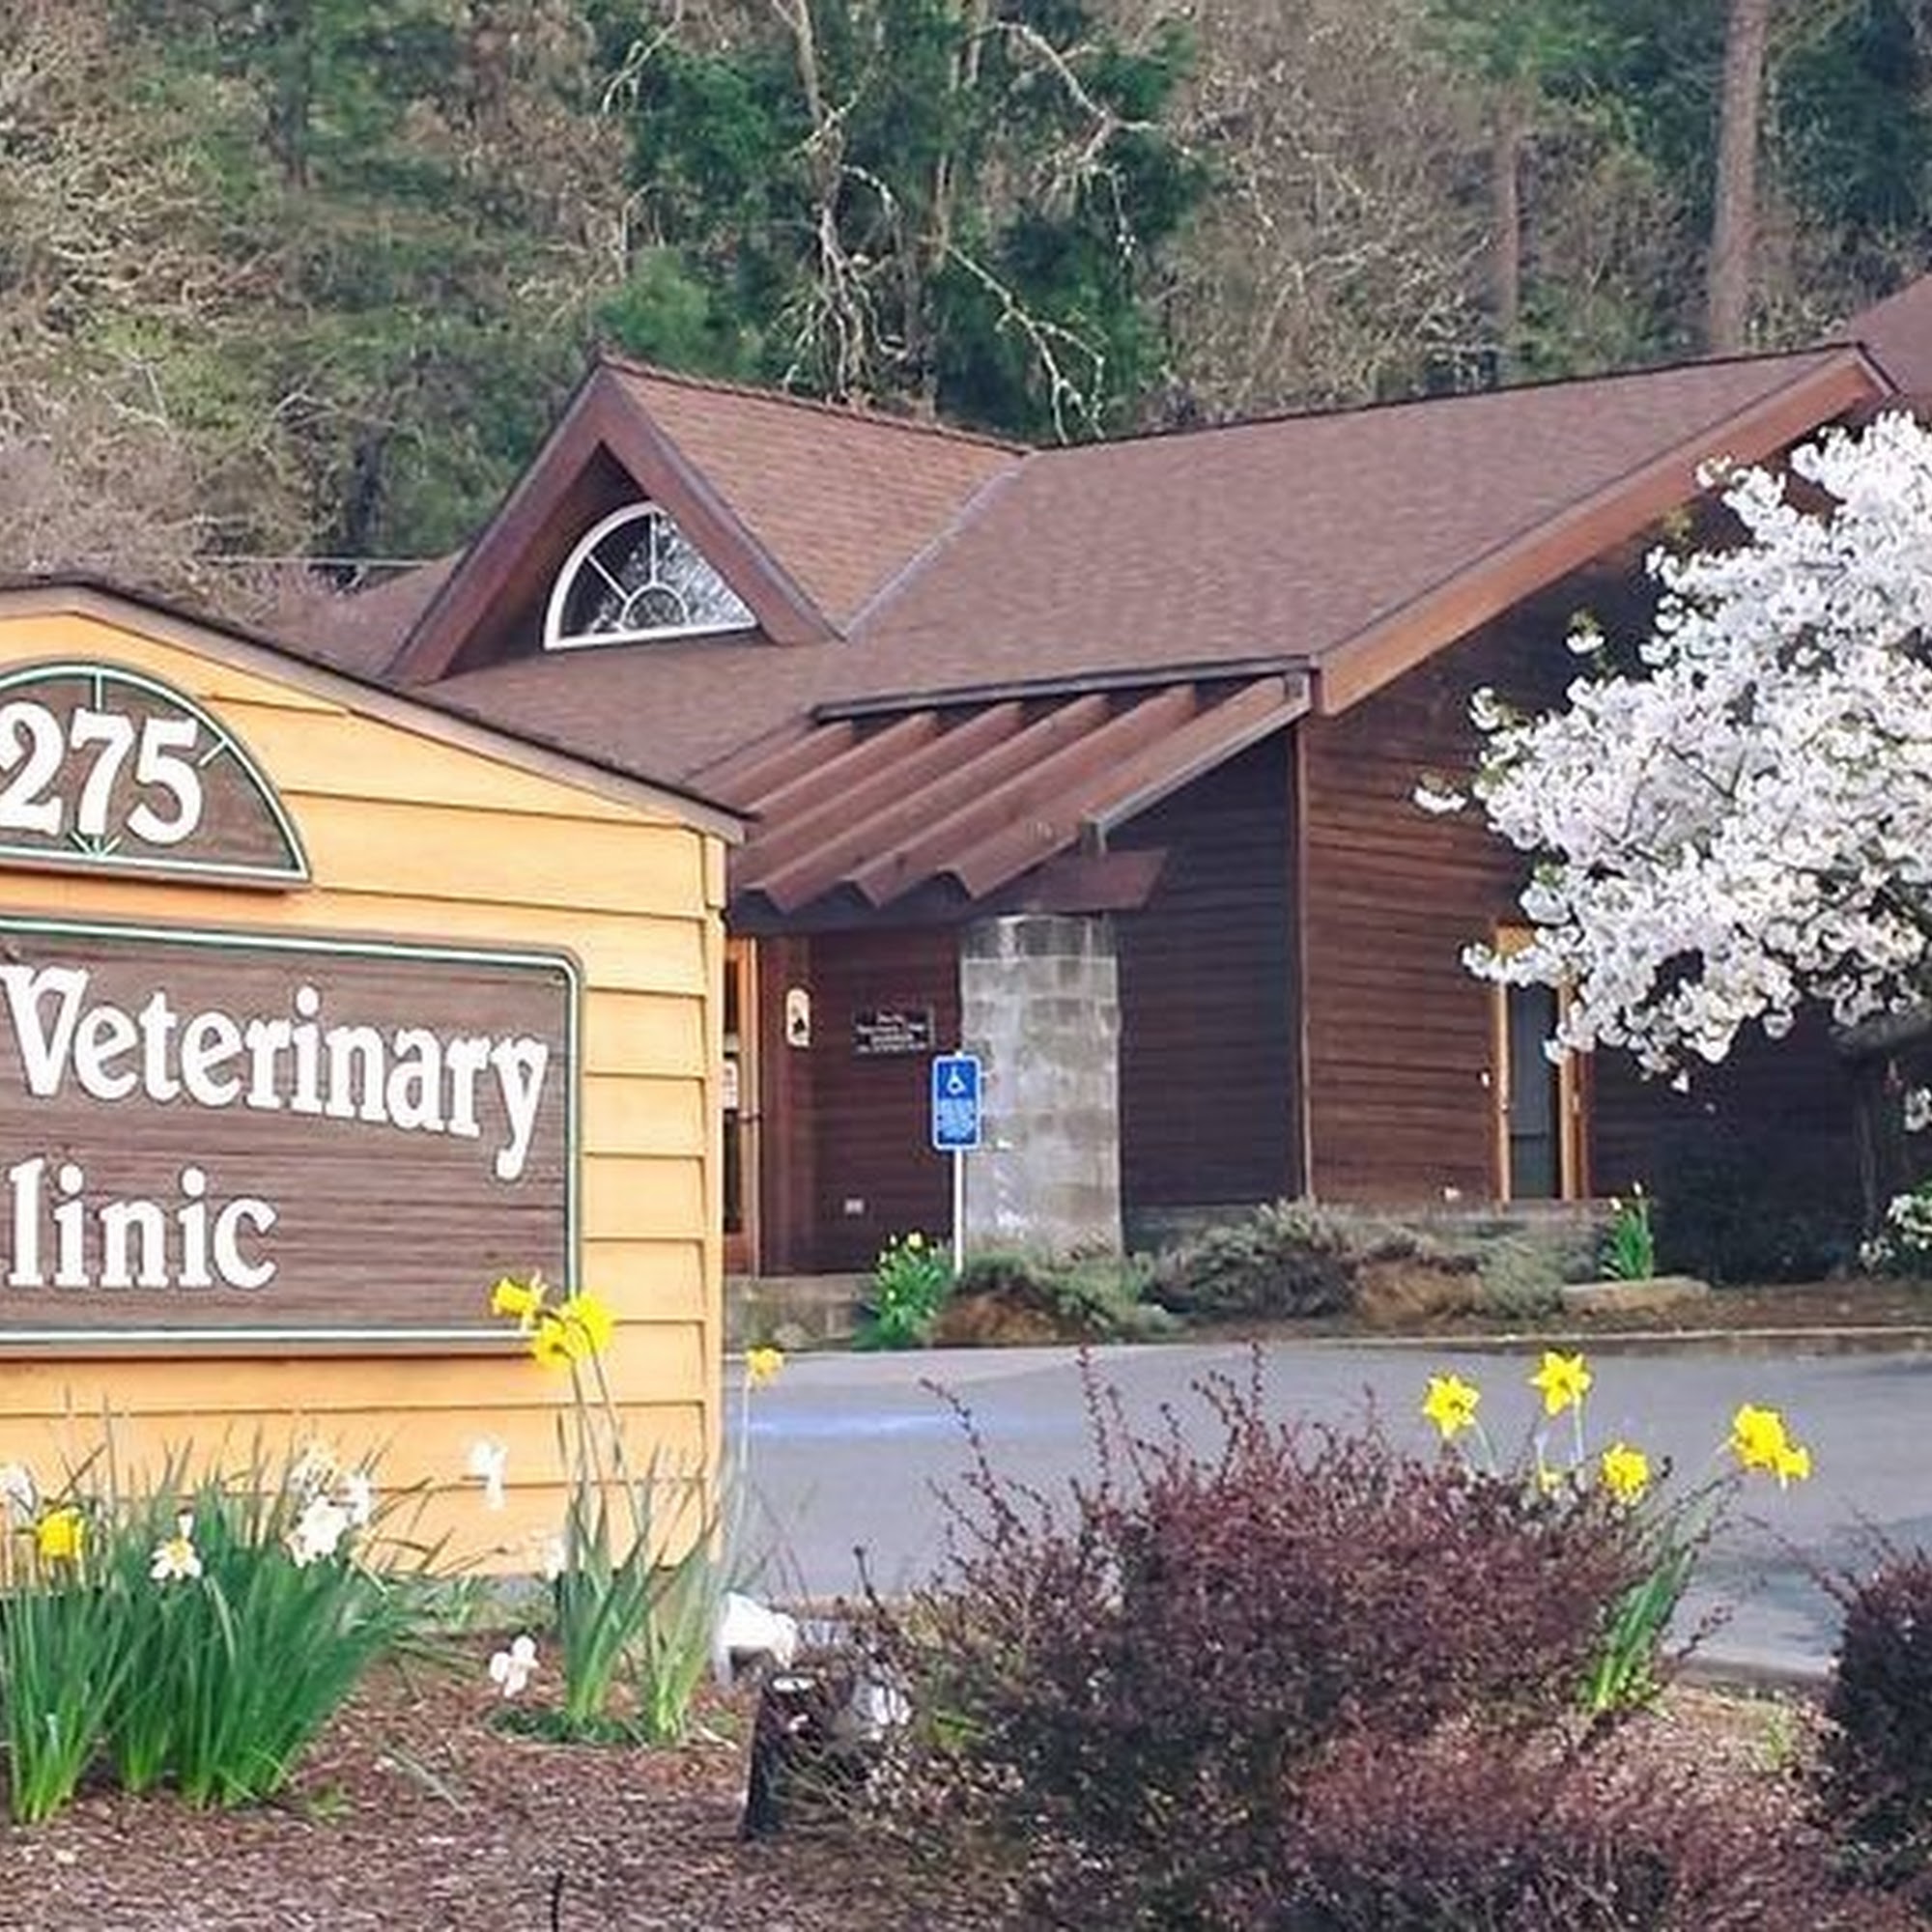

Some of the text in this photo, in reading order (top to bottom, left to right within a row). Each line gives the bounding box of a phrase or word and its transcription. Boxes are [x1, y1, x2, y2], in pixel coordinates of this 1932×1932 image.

[0, 702, 202, 843] 275
[0, 965, 548, 1179] Veterinary
[8, 1159, 277, 1289] linic
